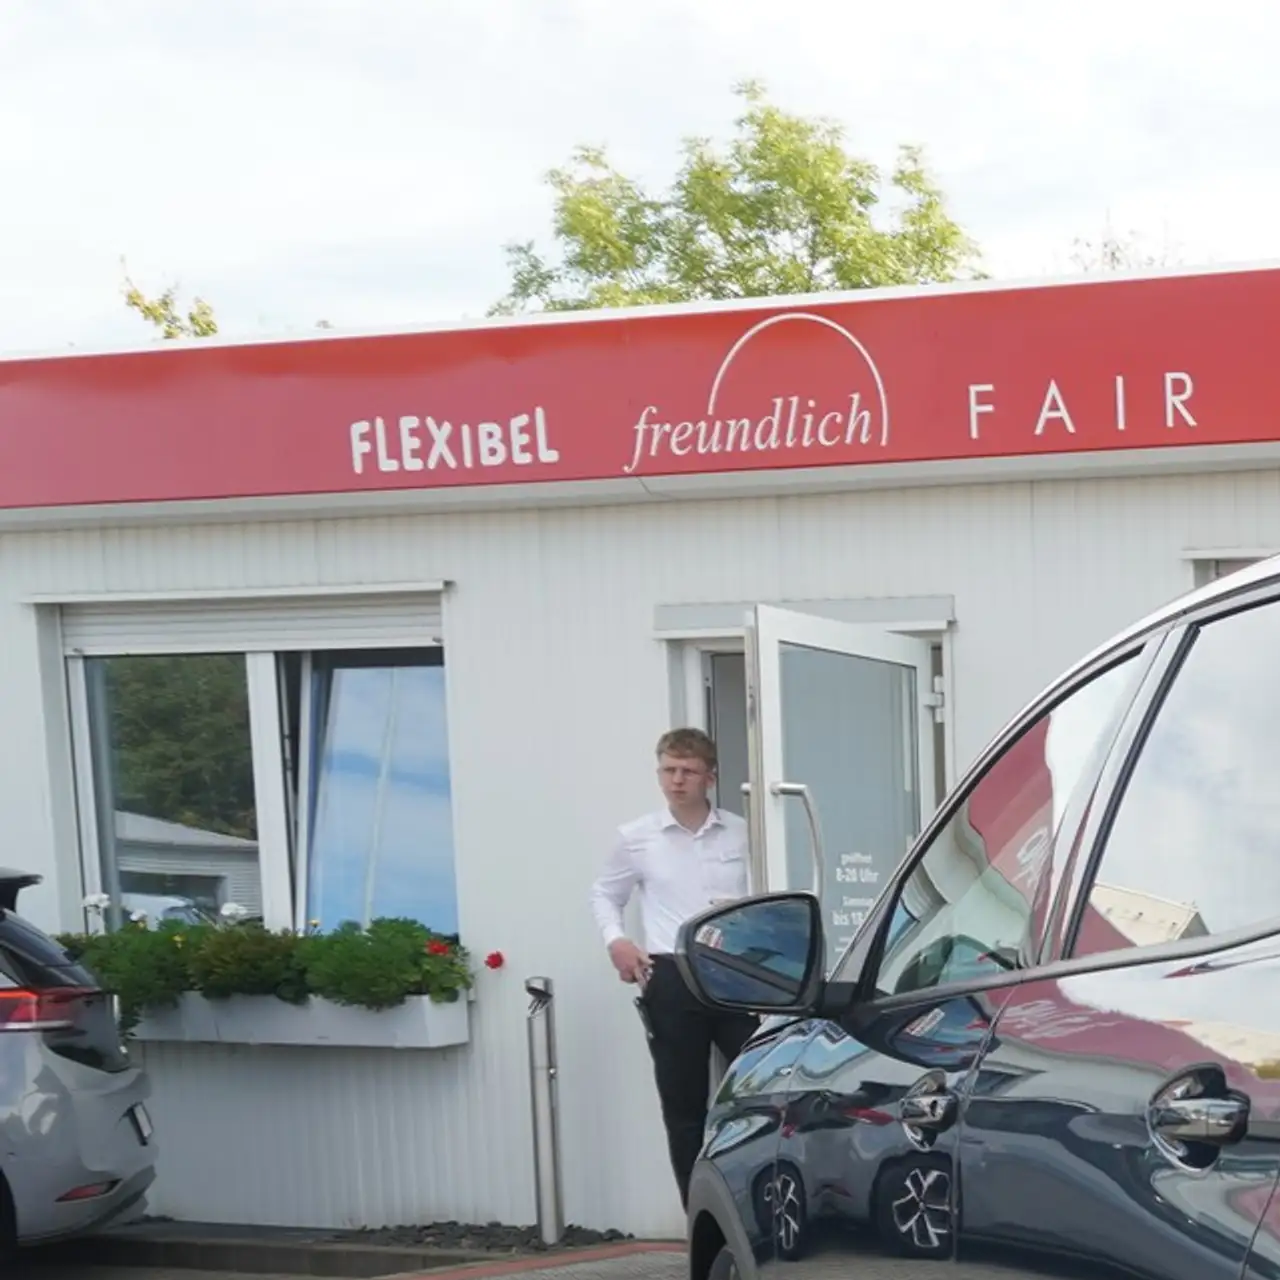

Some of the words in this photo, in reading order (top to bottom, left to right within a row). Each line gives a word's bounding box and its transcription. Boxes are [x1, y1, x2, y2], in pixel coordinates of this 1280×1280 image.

[349, 405, 560, 476] FLEXIBEL
[622, 392, 873, 473] freundlich
[967, 371, 1198, 440] FAIR
